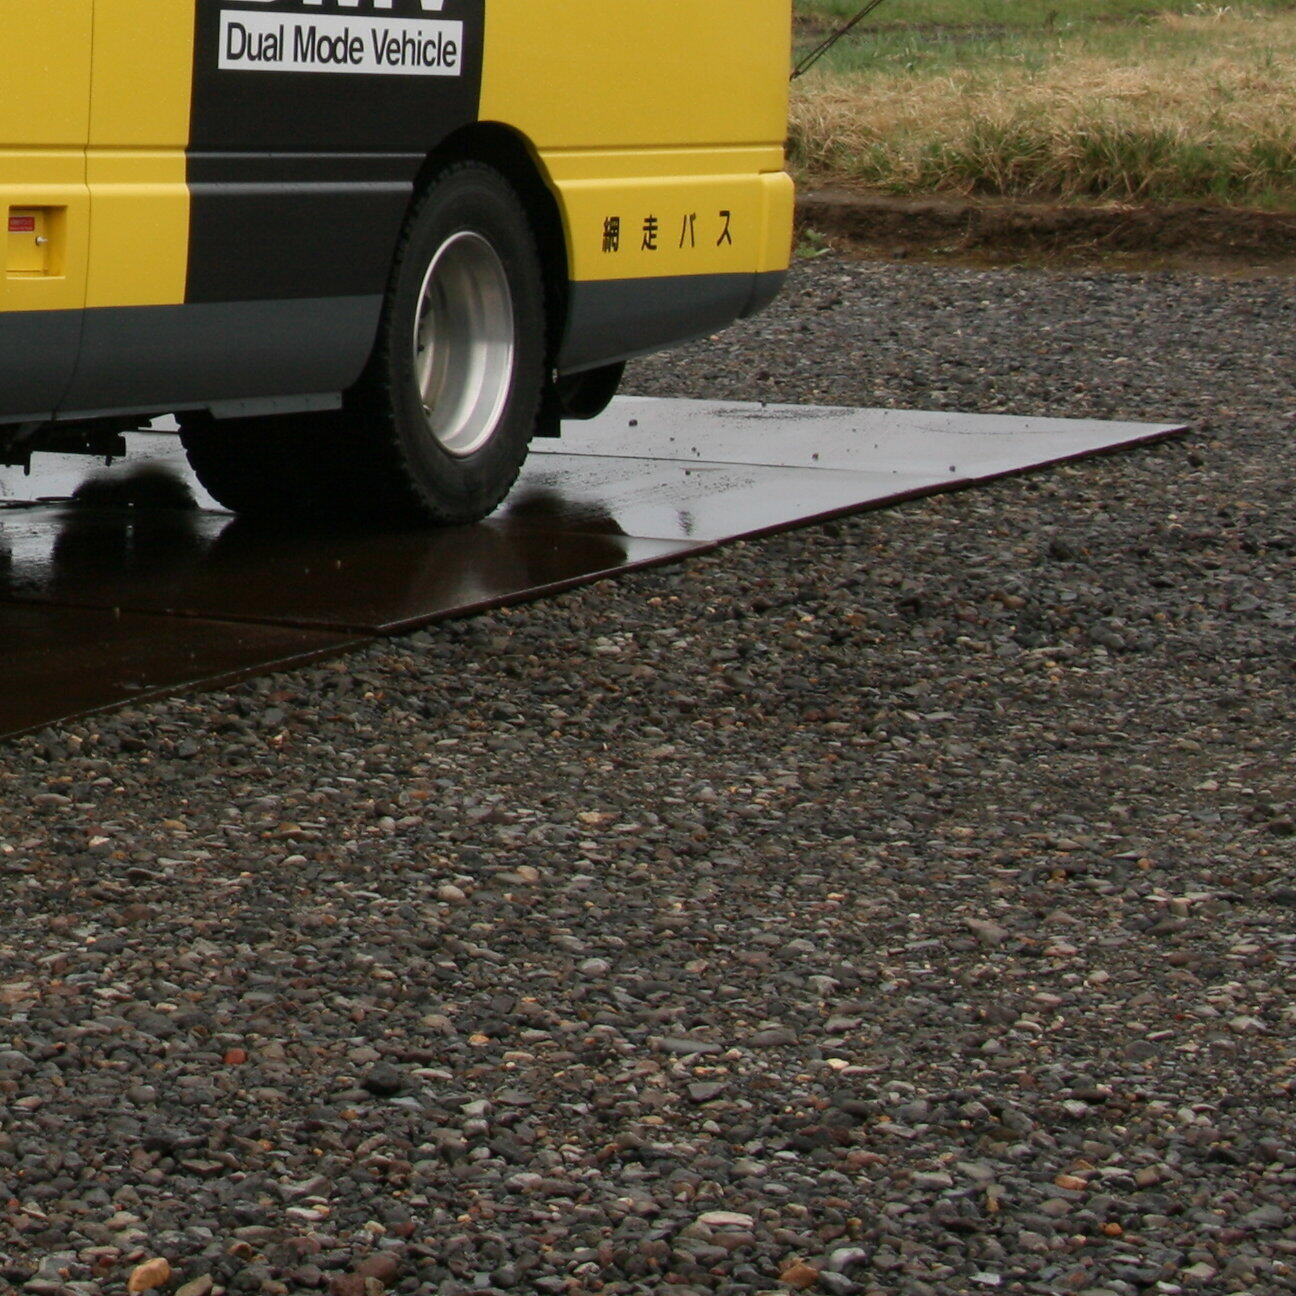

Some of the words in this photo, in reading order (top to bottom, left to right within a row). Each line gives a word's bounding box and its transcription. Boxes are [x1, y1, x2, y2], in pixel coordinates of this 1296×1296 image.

[225, 21, 284, 62] Dual
[293, 24, 364, 65] Mode
[370, 27, 457, 67] Vehicle
[601, 209, 733, 253] 網走バス
